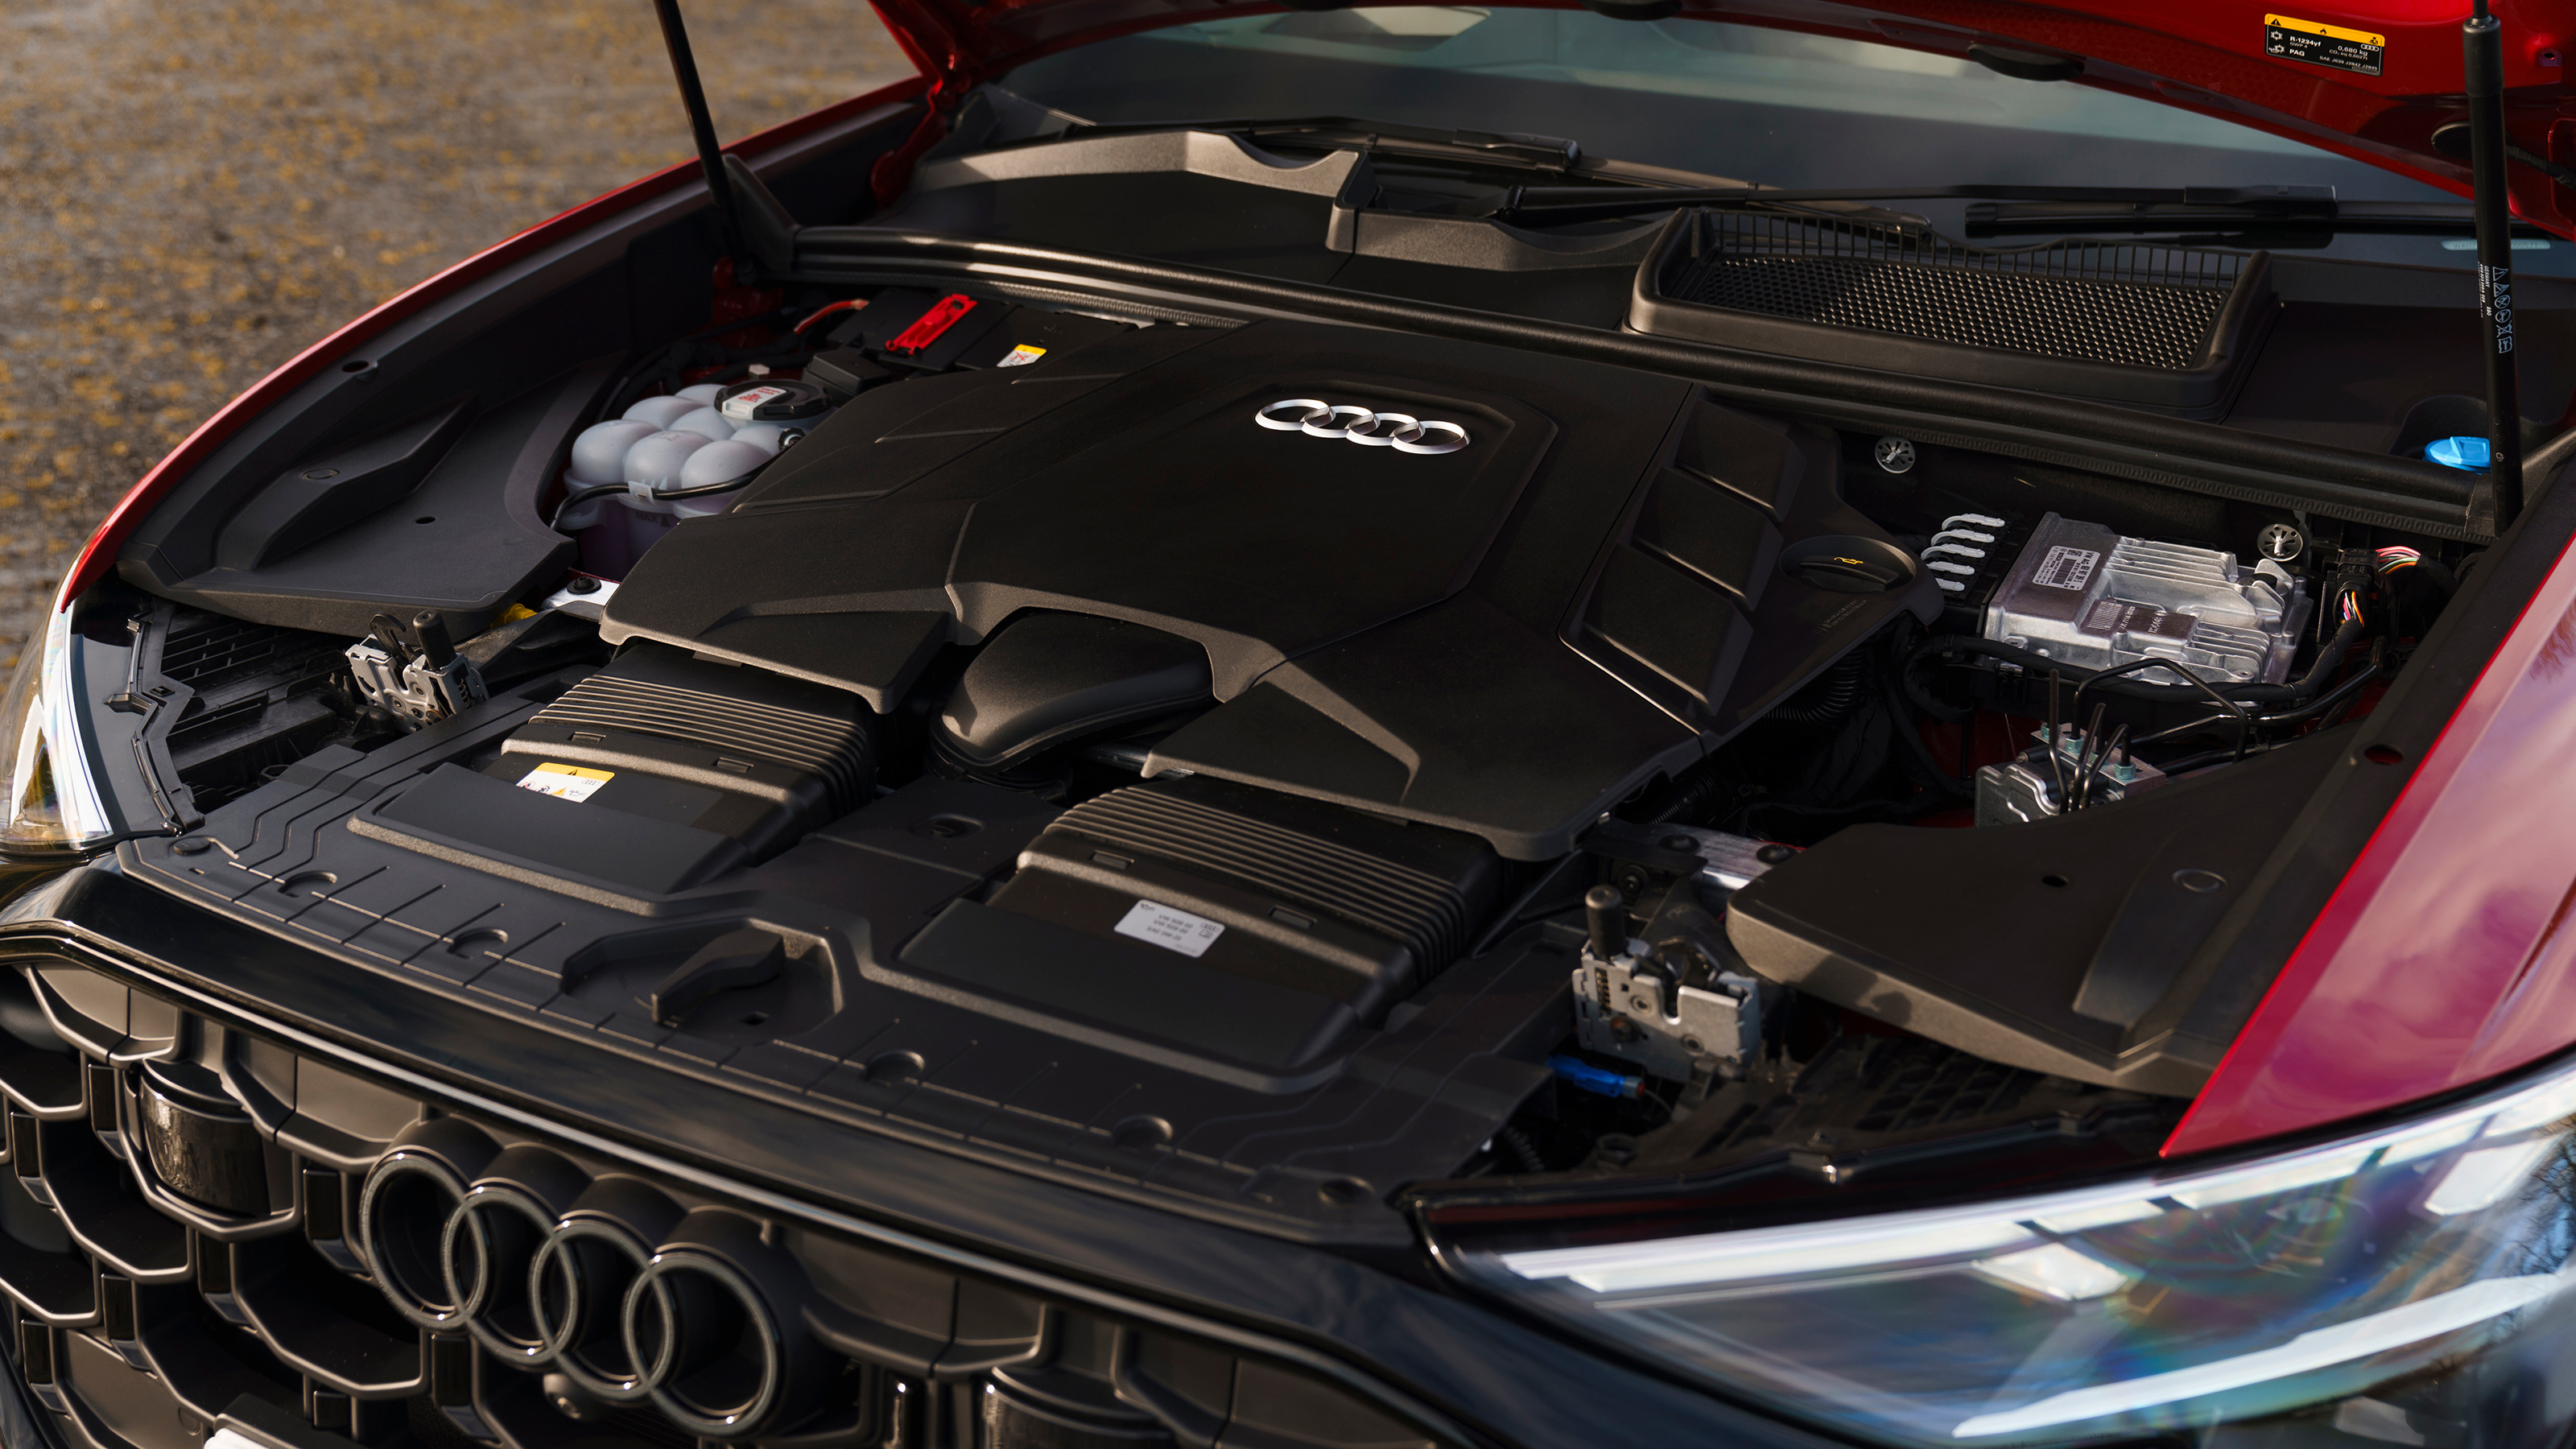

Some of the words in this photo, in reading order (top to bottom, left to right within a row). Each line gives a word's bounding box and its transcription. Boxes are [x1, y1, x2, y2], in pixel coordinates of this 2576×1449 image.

[2289, 35, 2322, 47] R-1234yf
[2289, 48, 2306, 56] PAG
[2338, 45, 2358, 54] 0,680
[636, 511, 658, 523] MAX
